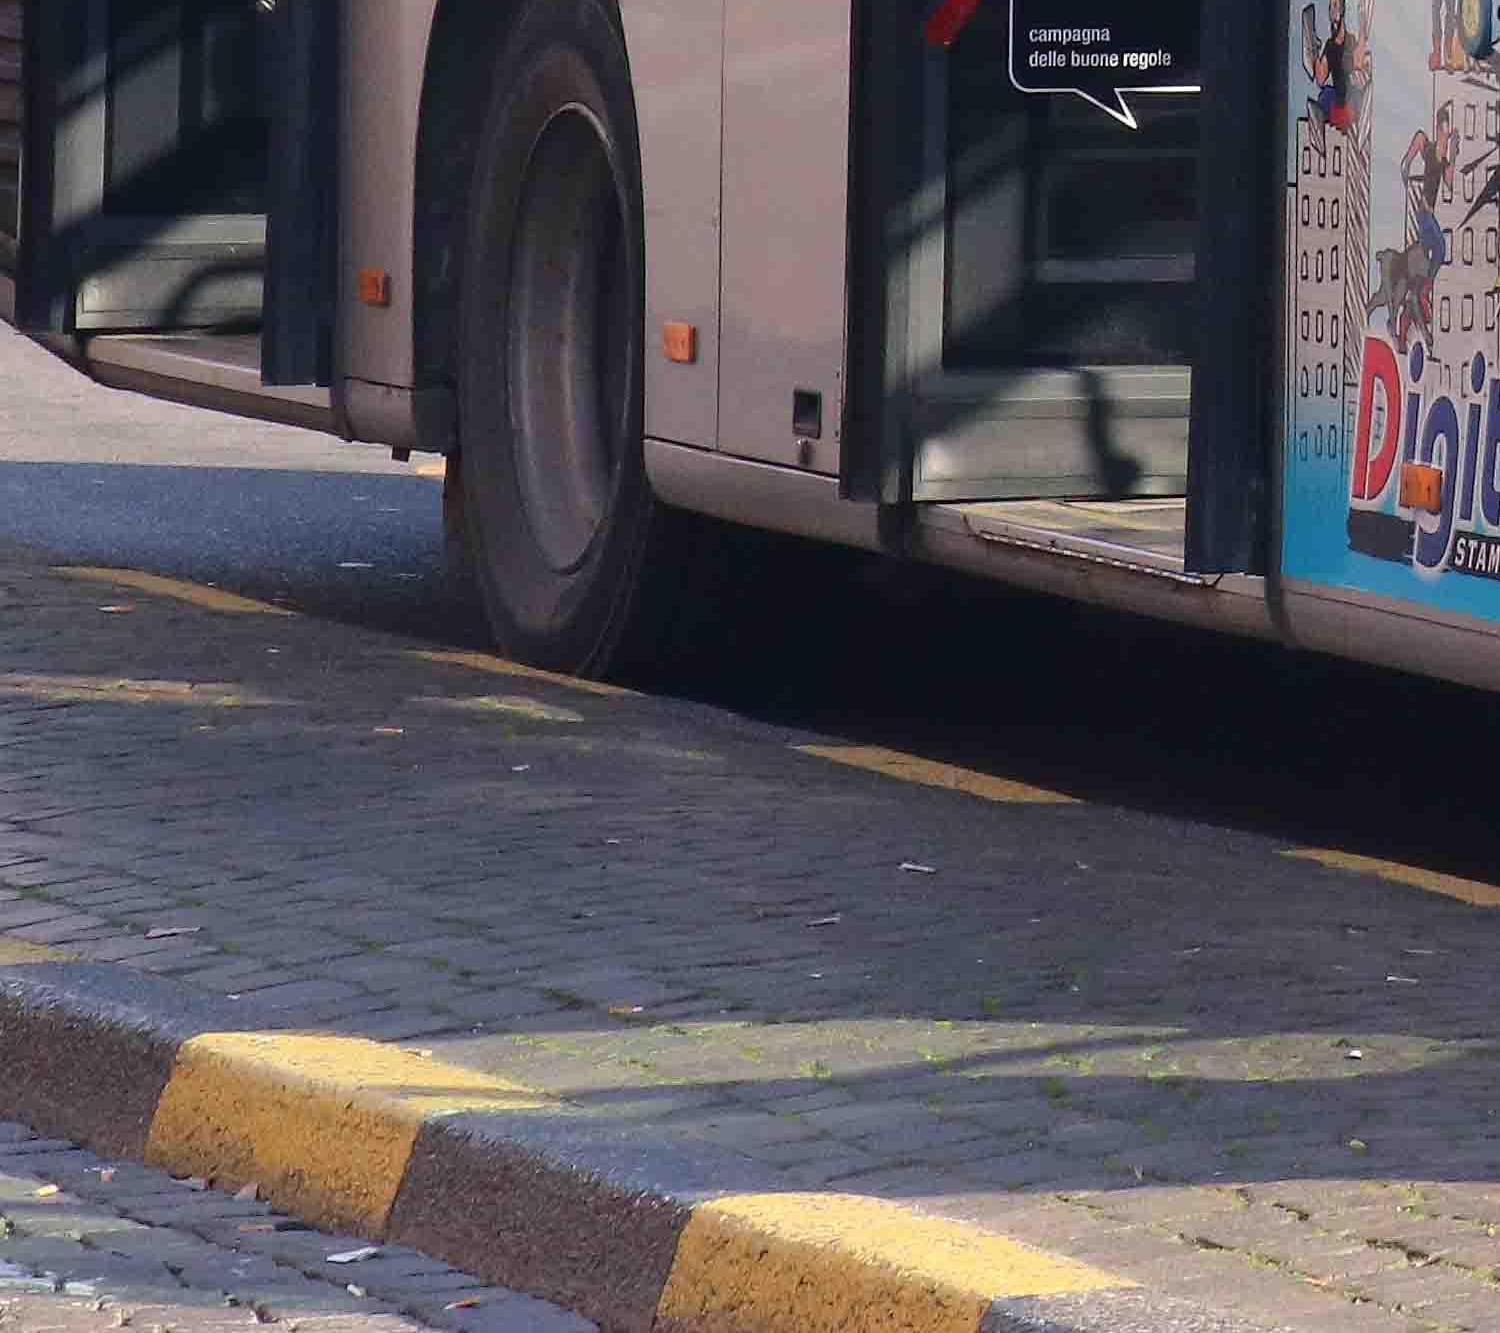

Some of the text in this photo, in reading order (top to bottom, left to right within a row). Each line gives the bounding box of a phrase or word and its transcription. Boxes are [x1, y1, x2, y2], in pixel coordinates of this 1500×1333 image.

[1029, 26, 1111, 45] campagna
[1029, 50, 1172, 70] delle buone regole
